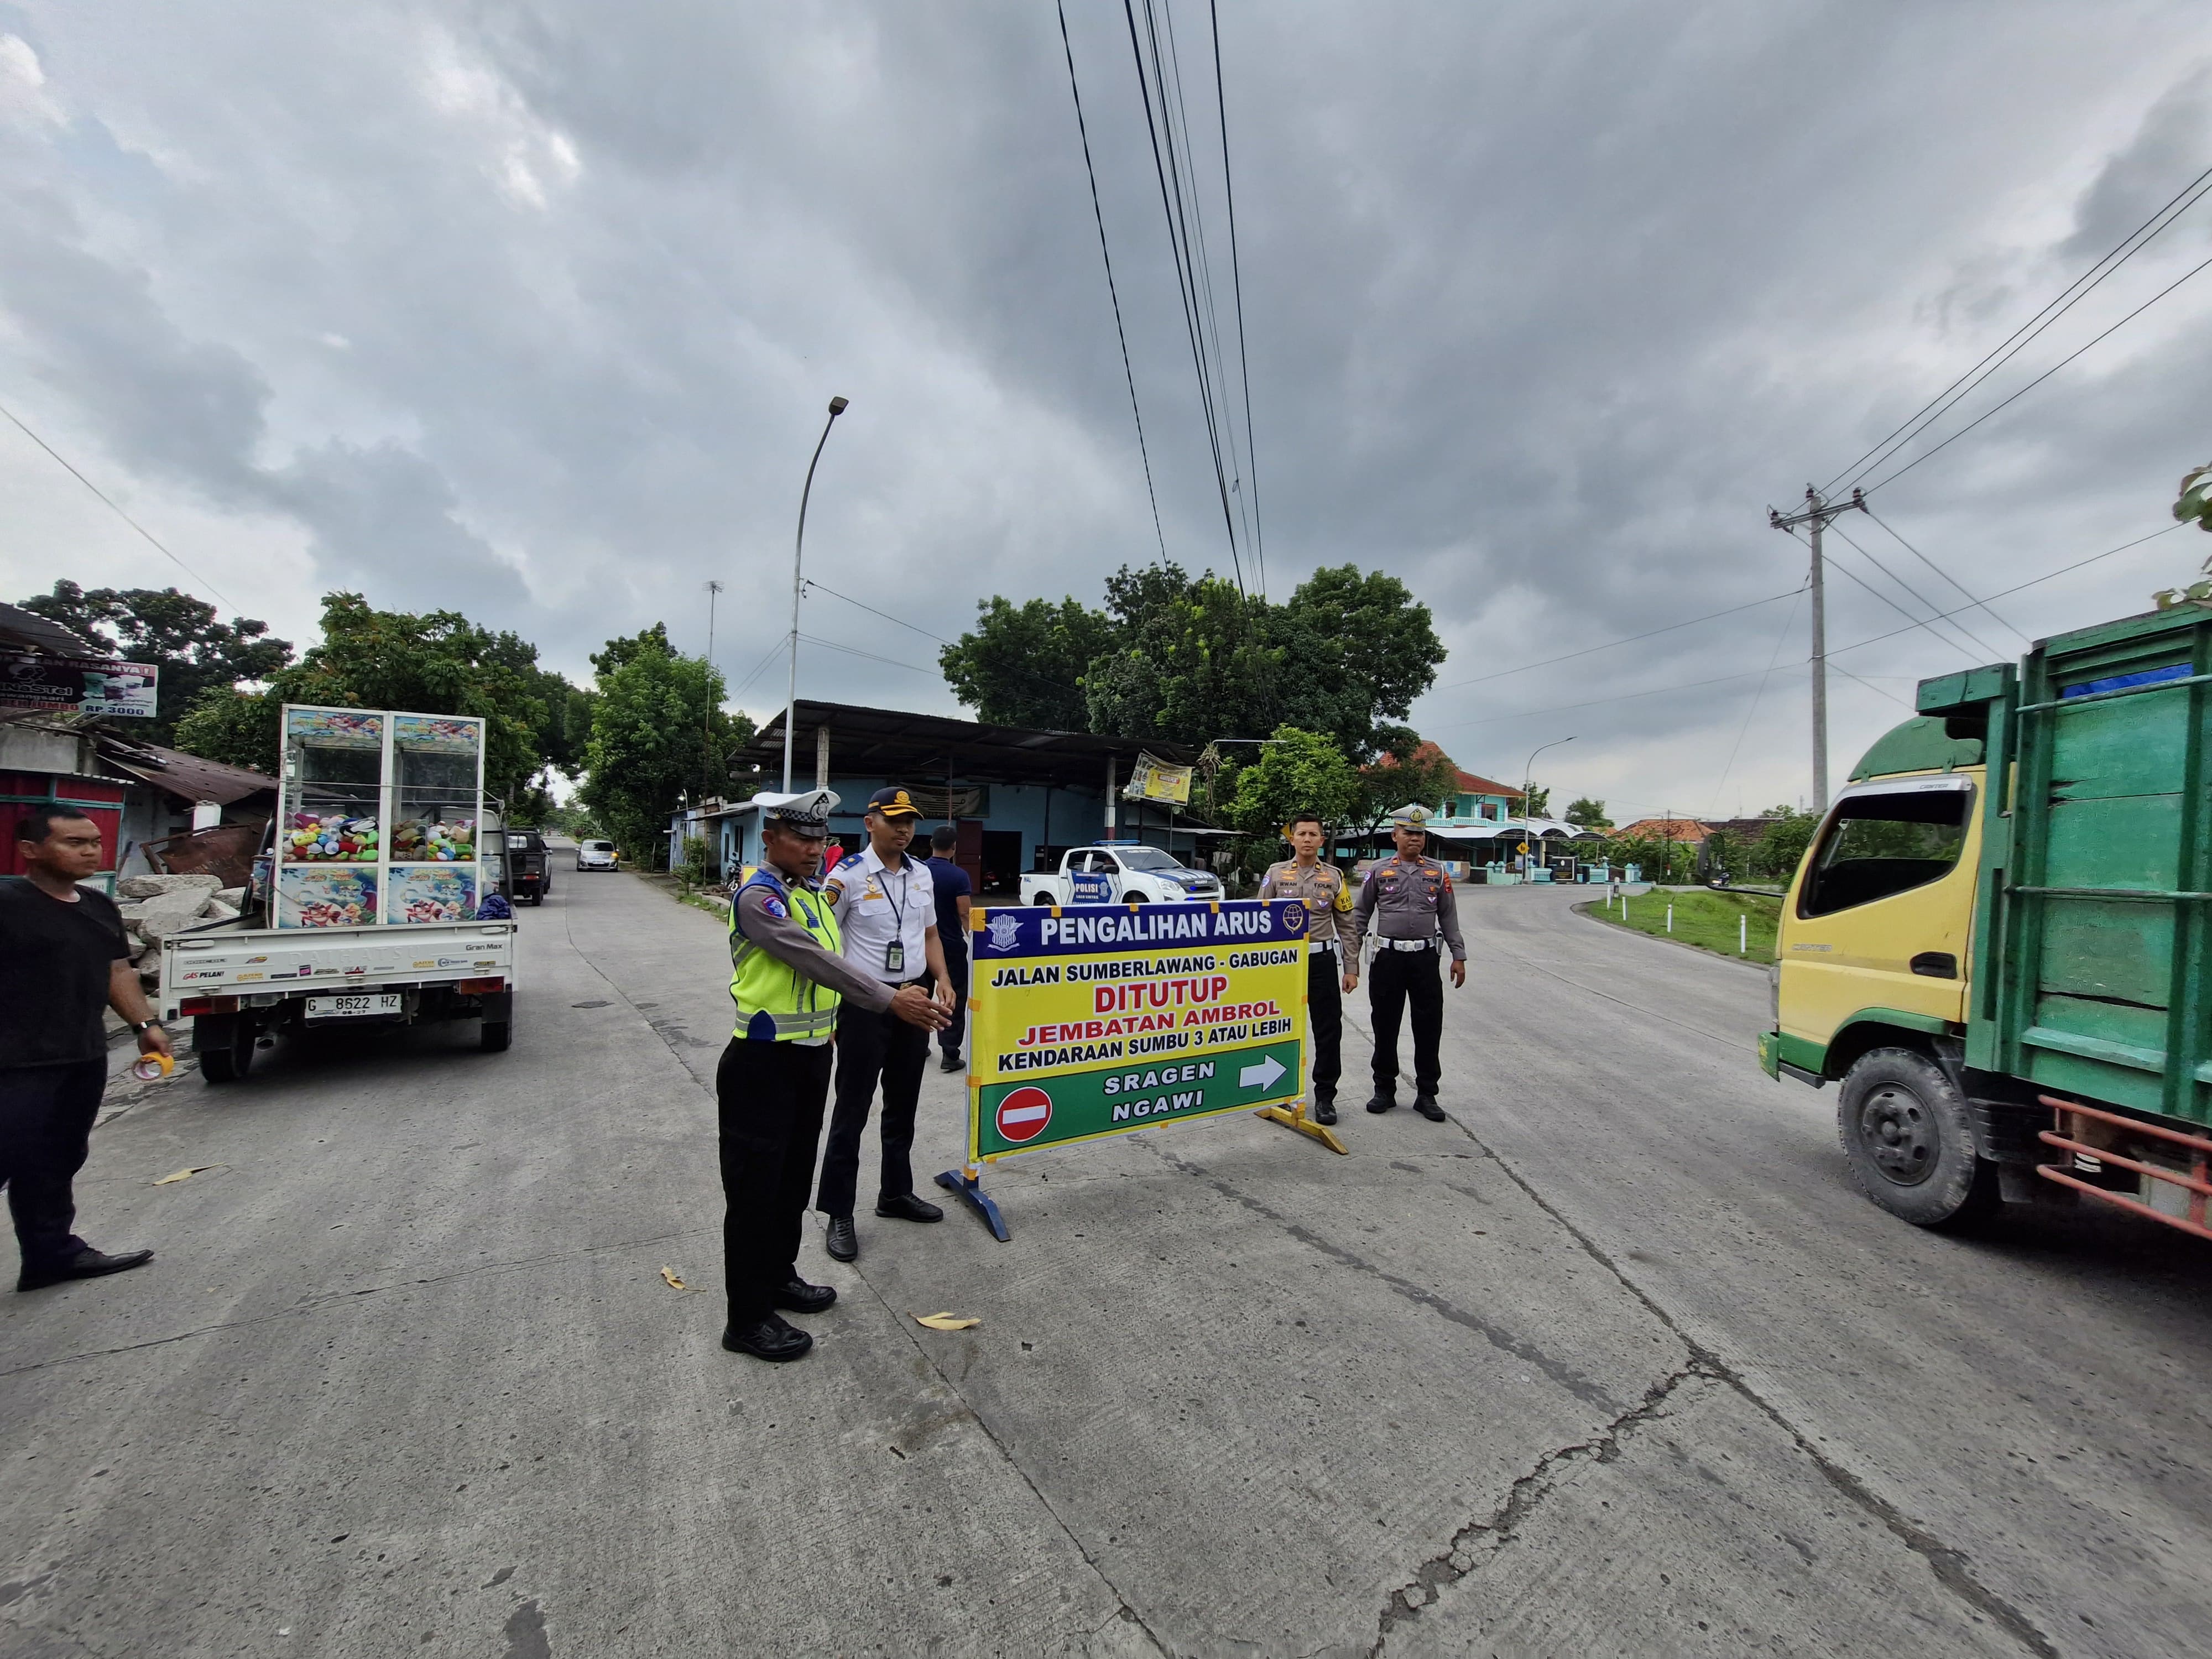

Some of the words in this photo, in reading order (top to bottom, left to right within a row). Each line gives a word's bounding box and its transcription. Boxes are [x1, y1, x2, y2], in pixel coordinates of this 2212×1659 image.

[68, 661, 141, 674] RASANYA
[31, 701, 79, 711] JUMBO
[108, 707, 144, 716] 3000
[1076, 883, 1098, 893] POLISI
[1041, 913, 1207, 945] PENGALIHAN
[1214, 910, 1271, 936] ARUS
[288, 946, 420, 966] DAIHATSU
[991, 966, 1060, 987] JALAN
[1066, 956, 1215, 982] SUMBERLAWANG
[1229, 949, 1297, 968] GABUGAN
[308, 999, 316, 1011] G
[336, 997, 371, 1010] 8622
[381, 995, 398, 1008] HZ
[1095, 976, 1227, 1013] DITUTUP
[1018, 1013, 1174, 1046] JEMBATAN
[1183, 1001, 1280, 1026] AMBROL
[998, 1041, 1123, 1071] KENDARAAN
[1128, 1032, 1188, 1055] SUMBU
[1194, 1030, 1203, 1045] 3
[1208, 1025, 1247, 1044] ATAU
[1251, 1018, 1291, 1037] LEBIH
[1104, 1061, 1215, 1094] SRAGEN
[1113, 1090, 1203, 1121] NGAWI
